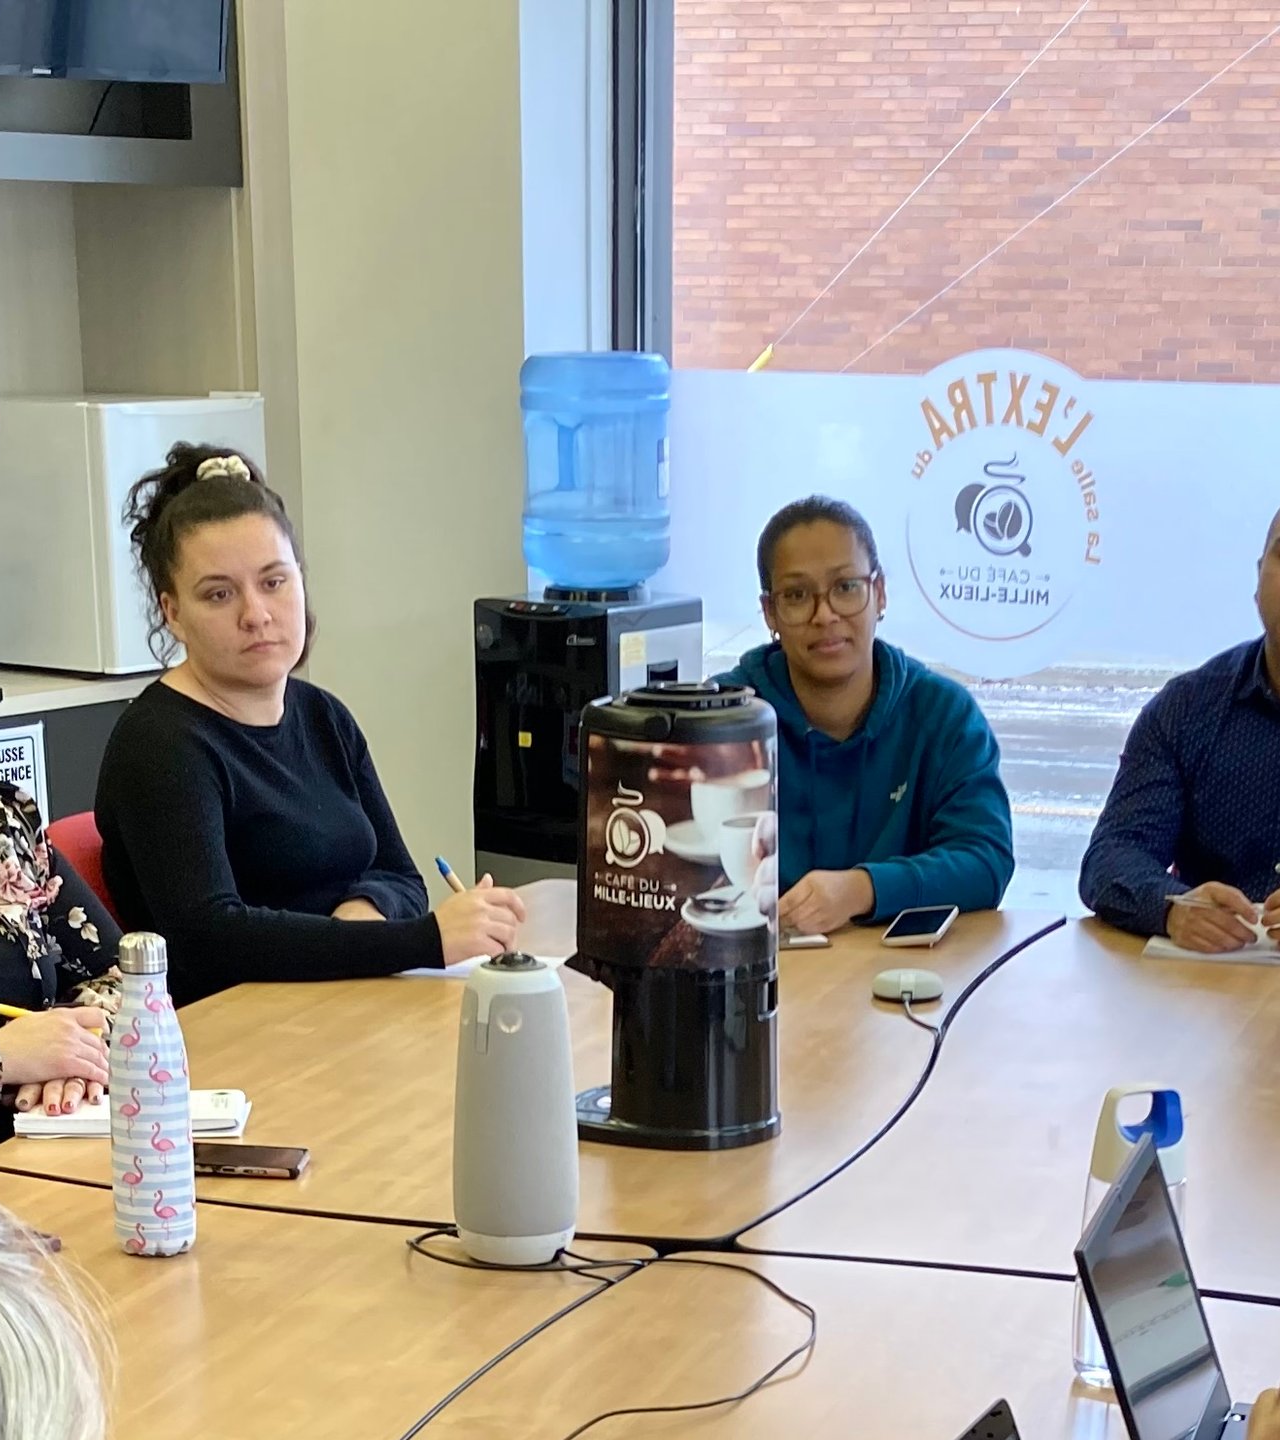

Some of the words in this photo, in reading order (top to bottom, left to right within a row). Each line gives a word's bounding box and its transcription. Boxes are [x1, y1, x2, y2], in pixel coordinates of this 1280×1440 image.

[605, 872, 635, 890] CAFÉ
[639, 878, 660, 893] DU
[593, 884, 676, 911] MILLE-LIEUX
